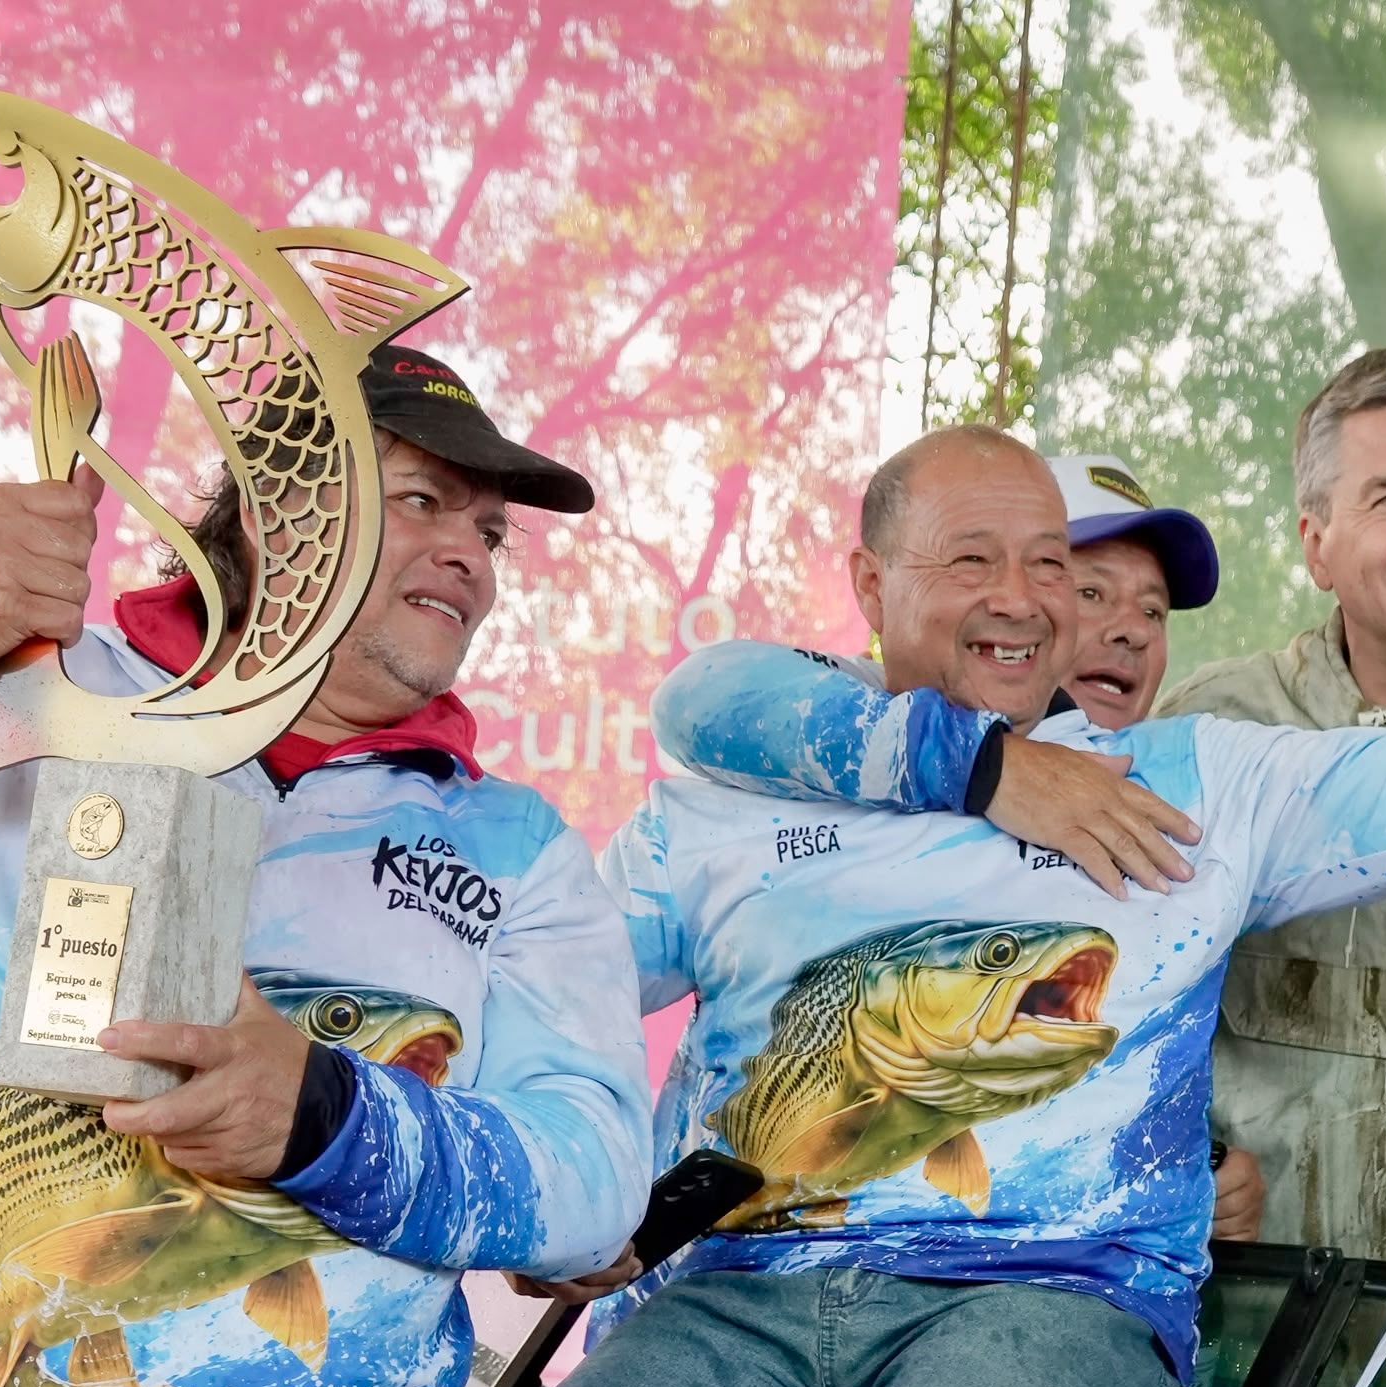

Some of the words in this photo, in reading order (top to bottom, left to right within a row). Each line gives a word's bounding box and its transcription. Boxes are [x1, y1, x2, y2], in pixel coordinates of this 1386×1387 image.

[462, 688, 705, 778] Cult
[414, 834, 457, 857] LOS
[776, 830, 841, 863] PESCA
[1032, 853, 1069, 871] DEL
[371, 835, 502, 921] KEYJOS
[387, 888, 428, 910] DEL
[428, 903, 494, 951] PARANÁ
[59, 937, 118, 958] puesto
[45, 972, 86, 987] Equipo
[89, 977, 102, 988] de
[55, 991, 87, 1001] pesca
[27, 1029, 77, 1043] Septiembre
[79, 1036, 99, 1046] 202
